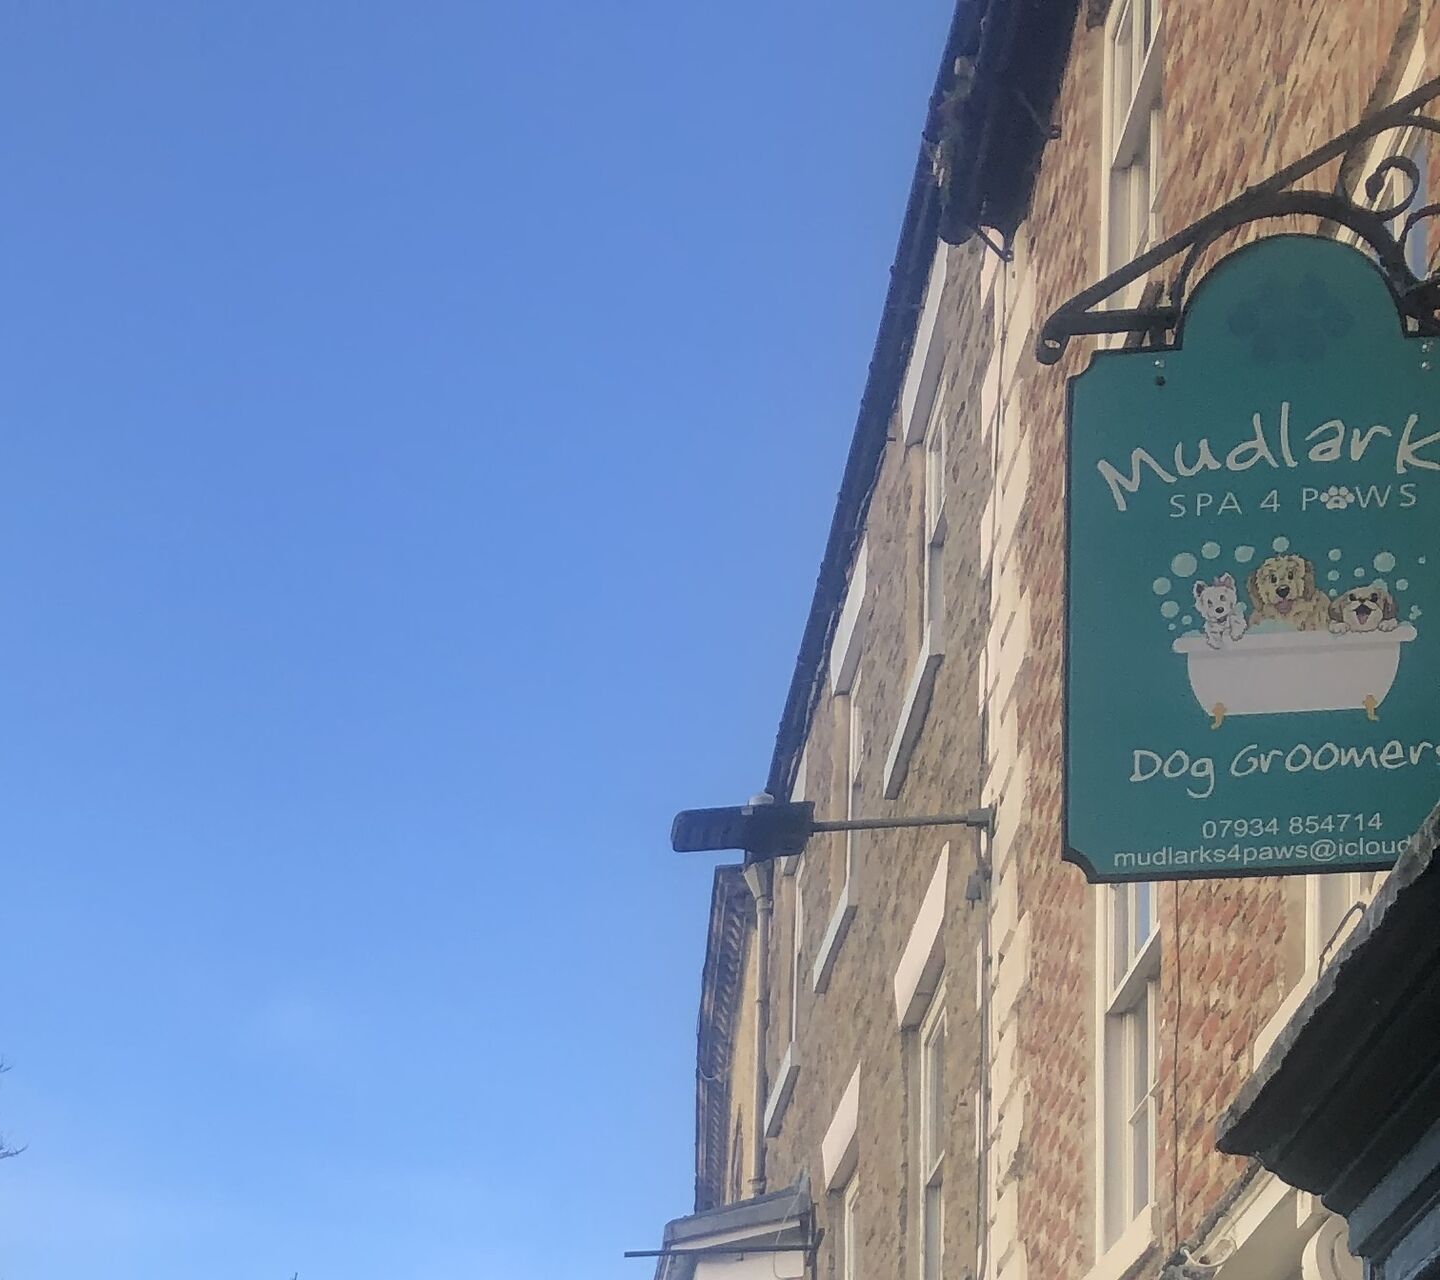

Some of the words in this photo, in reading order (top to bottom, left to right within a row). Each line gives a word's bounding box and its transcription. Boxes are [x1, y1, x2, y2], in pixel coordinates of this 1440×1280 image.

[1169, 491, 1243, 518] SPA
[1259, 488, 1281, 513] 4
[1229, 739, 1440, 777] Groomer
[1202, 816, 1280, 839] 07934
[1288, 812, 1383, 836] 854714
